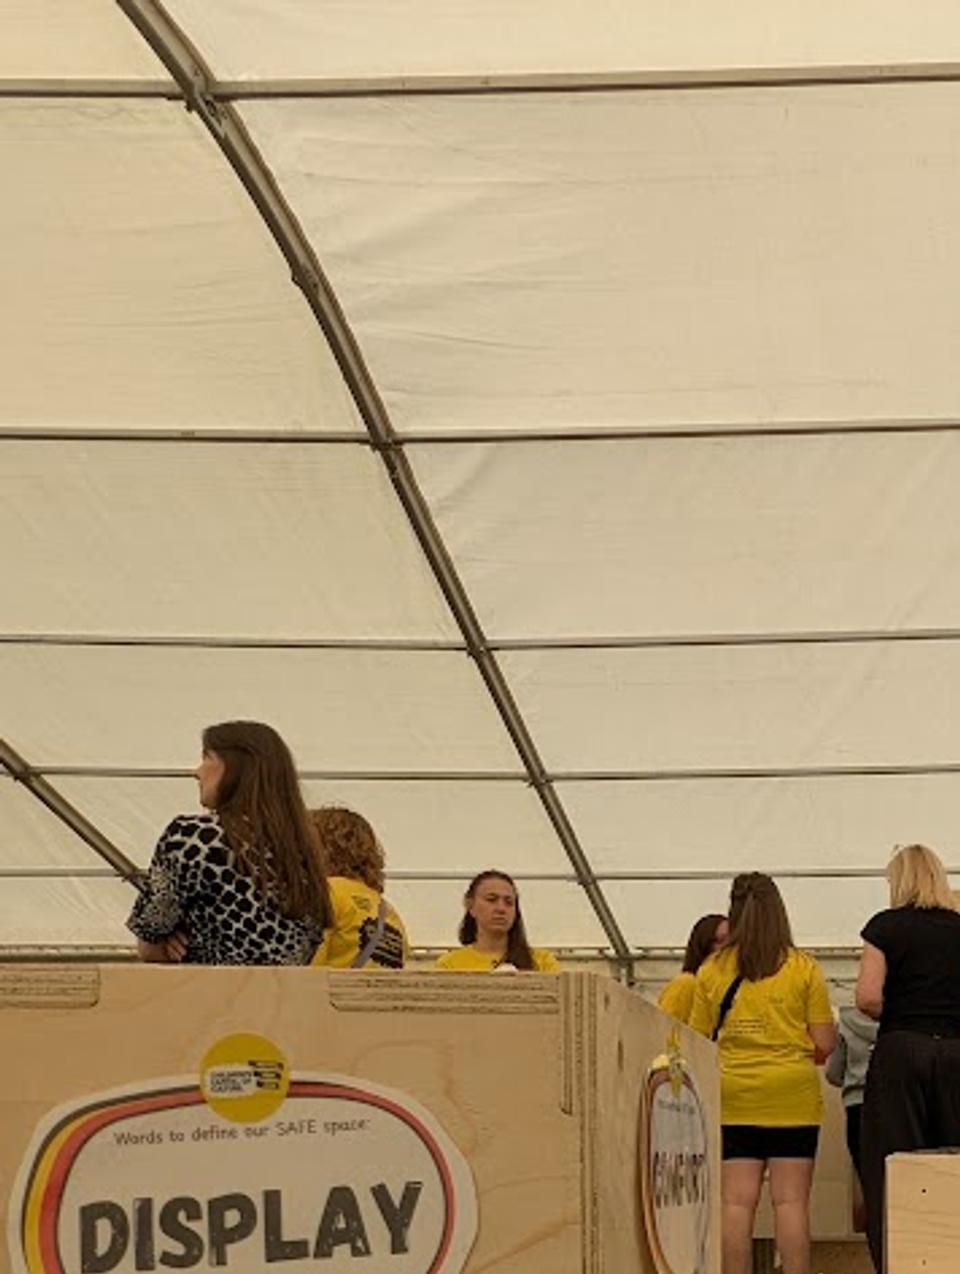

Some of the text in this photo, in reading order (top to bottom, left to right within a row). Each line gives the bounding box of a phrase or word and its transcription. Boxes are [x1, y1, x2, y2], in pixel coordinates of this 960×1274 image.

[113, 1130, 163, 1146] Words
[169, 1129, 184, 1142] to
[191, 1122, 238, 1142] define
[244, 1123, 268, 1137] our
[275, 1119, 316, 1137] SAFE
